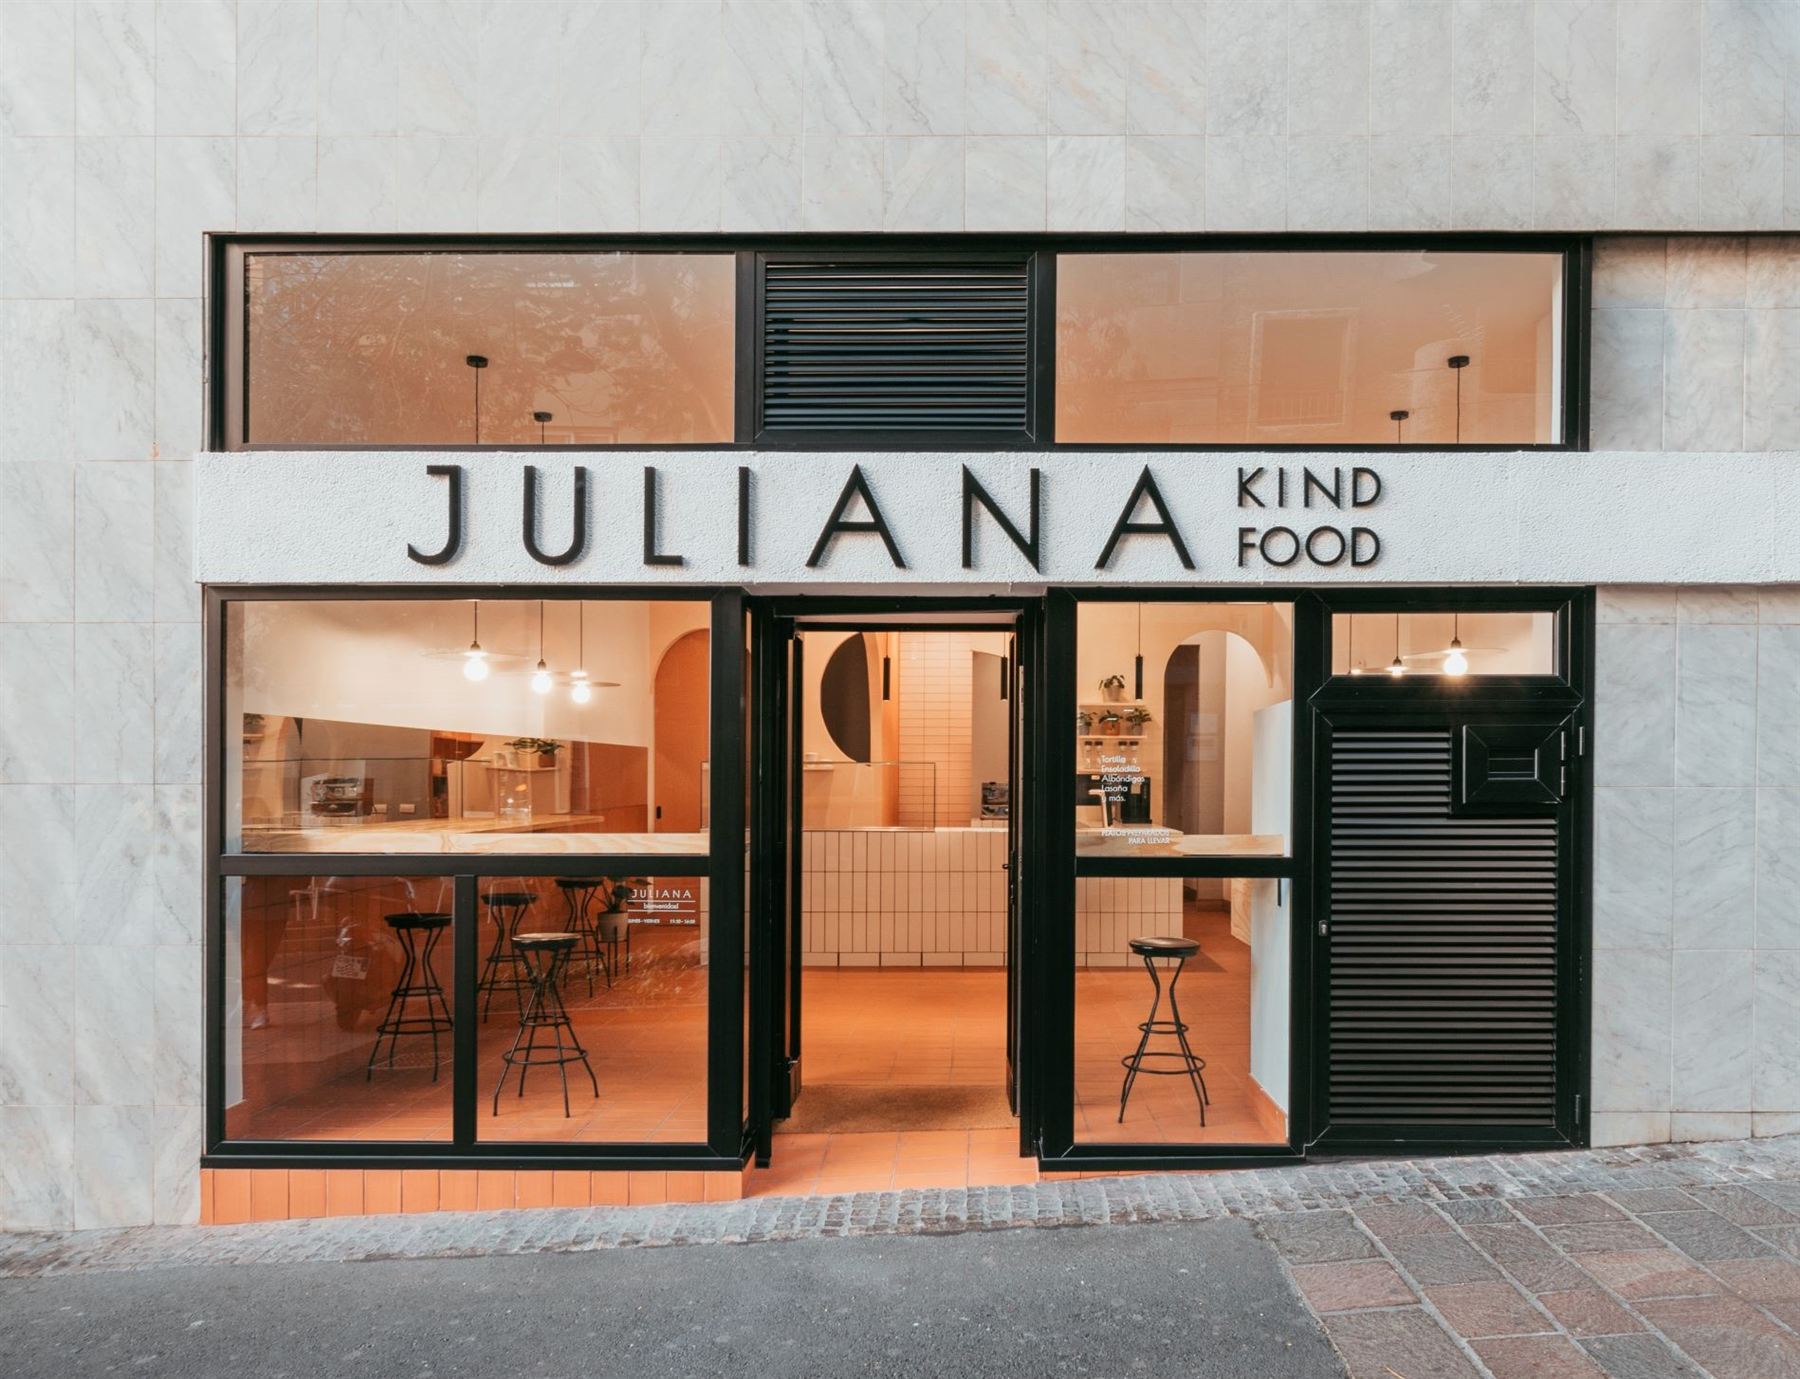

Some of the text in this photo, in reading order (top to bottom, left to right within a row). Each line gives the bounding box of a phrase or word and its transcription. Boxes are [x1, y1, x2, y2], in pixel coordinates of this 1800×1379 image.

[1237, 467, 1382, 509] KIND
[408, 464, 1195, 573] JULIANA
[1237, 526, 1381, 567] FOOD
[1101, 755, 1126, 763] Tortilla
[1101, 764, 1141, 772] Ensaladilla
[1101, 774, 1145, 784] Albóndigas
[1101, 784, 1128, 792] Lasaña
[1128, 837, 1170, 845] PARA LLEVAR
[631, 889, 692, 898] JULIANA
